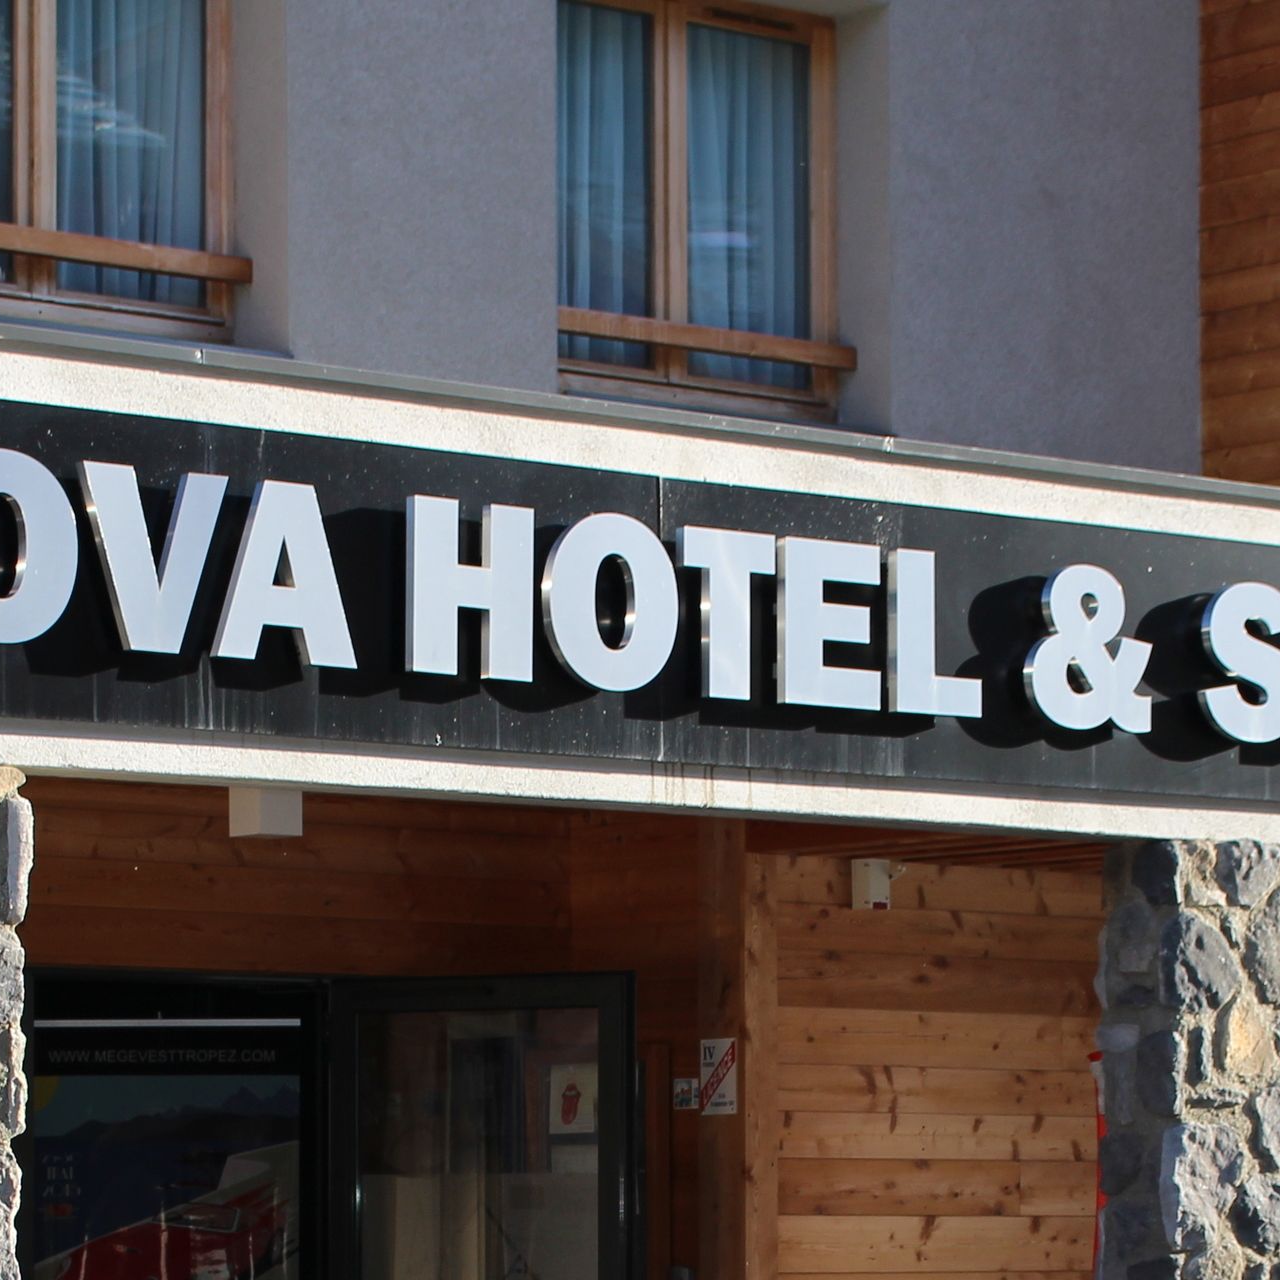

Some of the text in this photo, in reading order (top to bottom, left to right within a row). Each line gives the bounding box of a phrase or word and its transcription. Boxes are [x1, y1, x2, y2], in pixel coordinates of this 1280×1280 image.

[405, 494, 983, 717] HOTEL
[1023, 563, 1153, 734] &
[48, 1050, 276, 1063] WWW.MEGEVESTTROPEZ.COM
